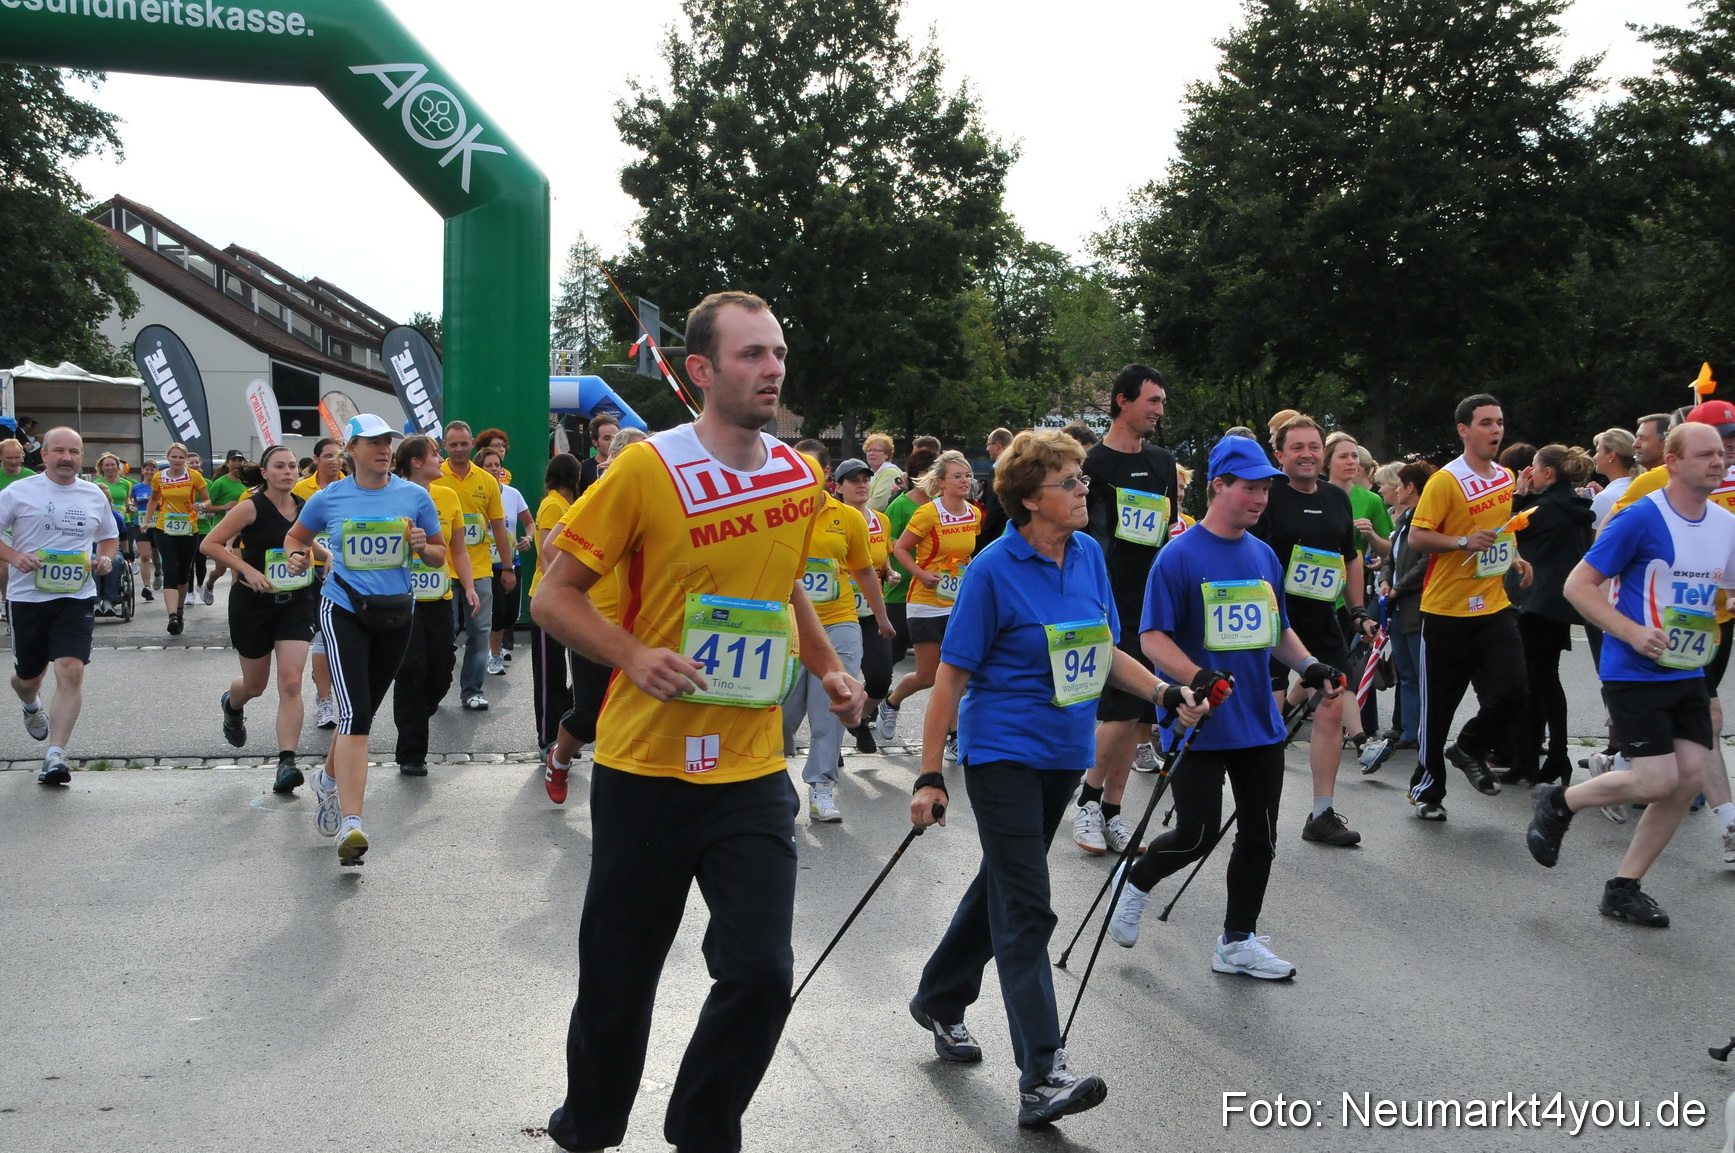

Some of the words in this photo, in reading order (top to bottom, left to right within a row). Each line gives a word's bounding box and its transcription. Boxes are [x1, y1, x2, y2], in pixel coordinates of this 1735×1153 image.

[348, 62, 507, 194] AOK
[1469, 498, 1496, 516] MAX
[166, 520, 187, 530] 437
[690, 513, 758, 548] MAX
[764, 496, 814, 528] BÖGL
[1122, 506, 1155, 532] 514
[942, 526, 960, 535] MAX
[346, 536, 402, 555] 1097
[1480, 543, 1508, 566] 405
[40, 564, 83, 581] 1095
[268, 563, 307, 578] 10
[410, 572, 440, 588] 690
[1294, 564, 1336, 588] 515
[1673, 570, 1710, 578] expert
[1213, 604, 1262, 632] 159
[1669, 628, 1706, 656] 674
[692, 634, 772, 680] 411
[1064, 646, 1096, 682] 94
[712, 678, 734, 689] Tino
[1063, 682, 1088, 692] Wolfgang
